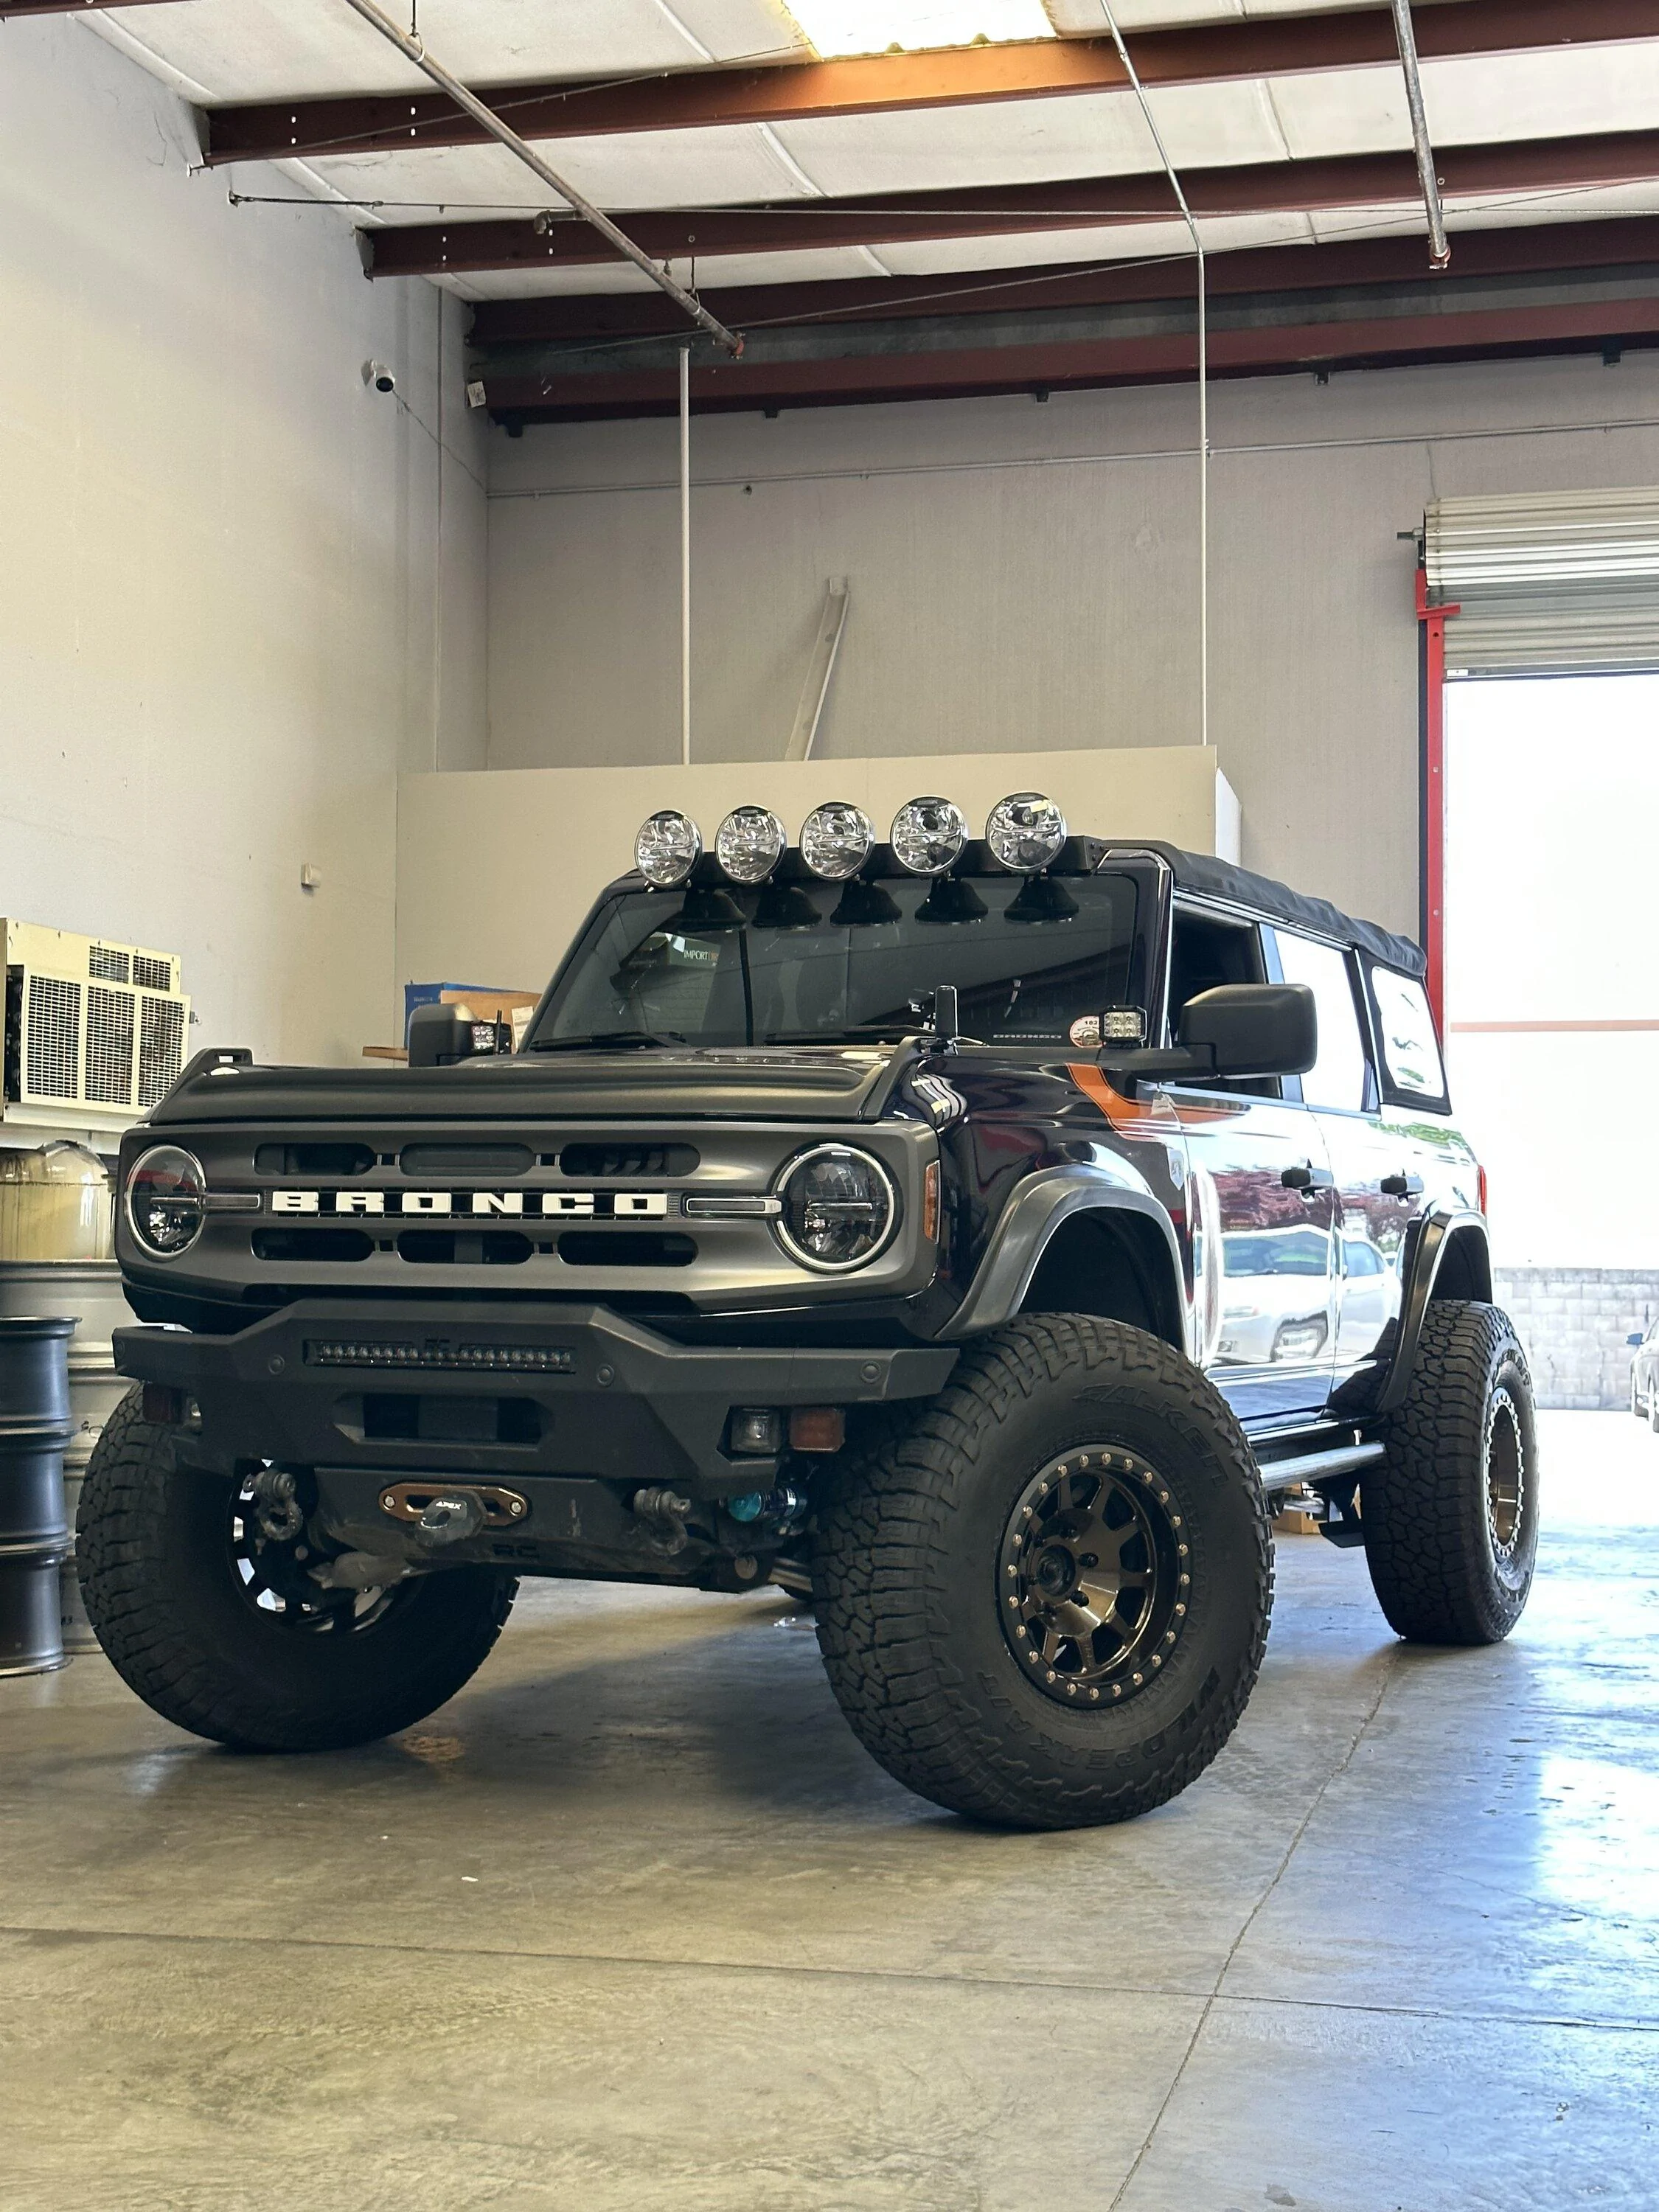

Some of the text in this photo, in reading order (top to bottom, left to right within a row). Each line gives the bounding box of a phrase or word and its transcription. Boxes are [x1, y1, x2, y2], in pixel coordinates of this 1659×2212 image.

[684, 950, 708, 960] IMPORT
[272, 1191, 668, 1214] BRONCO
[436, 1501, 462, 1510] APEX
